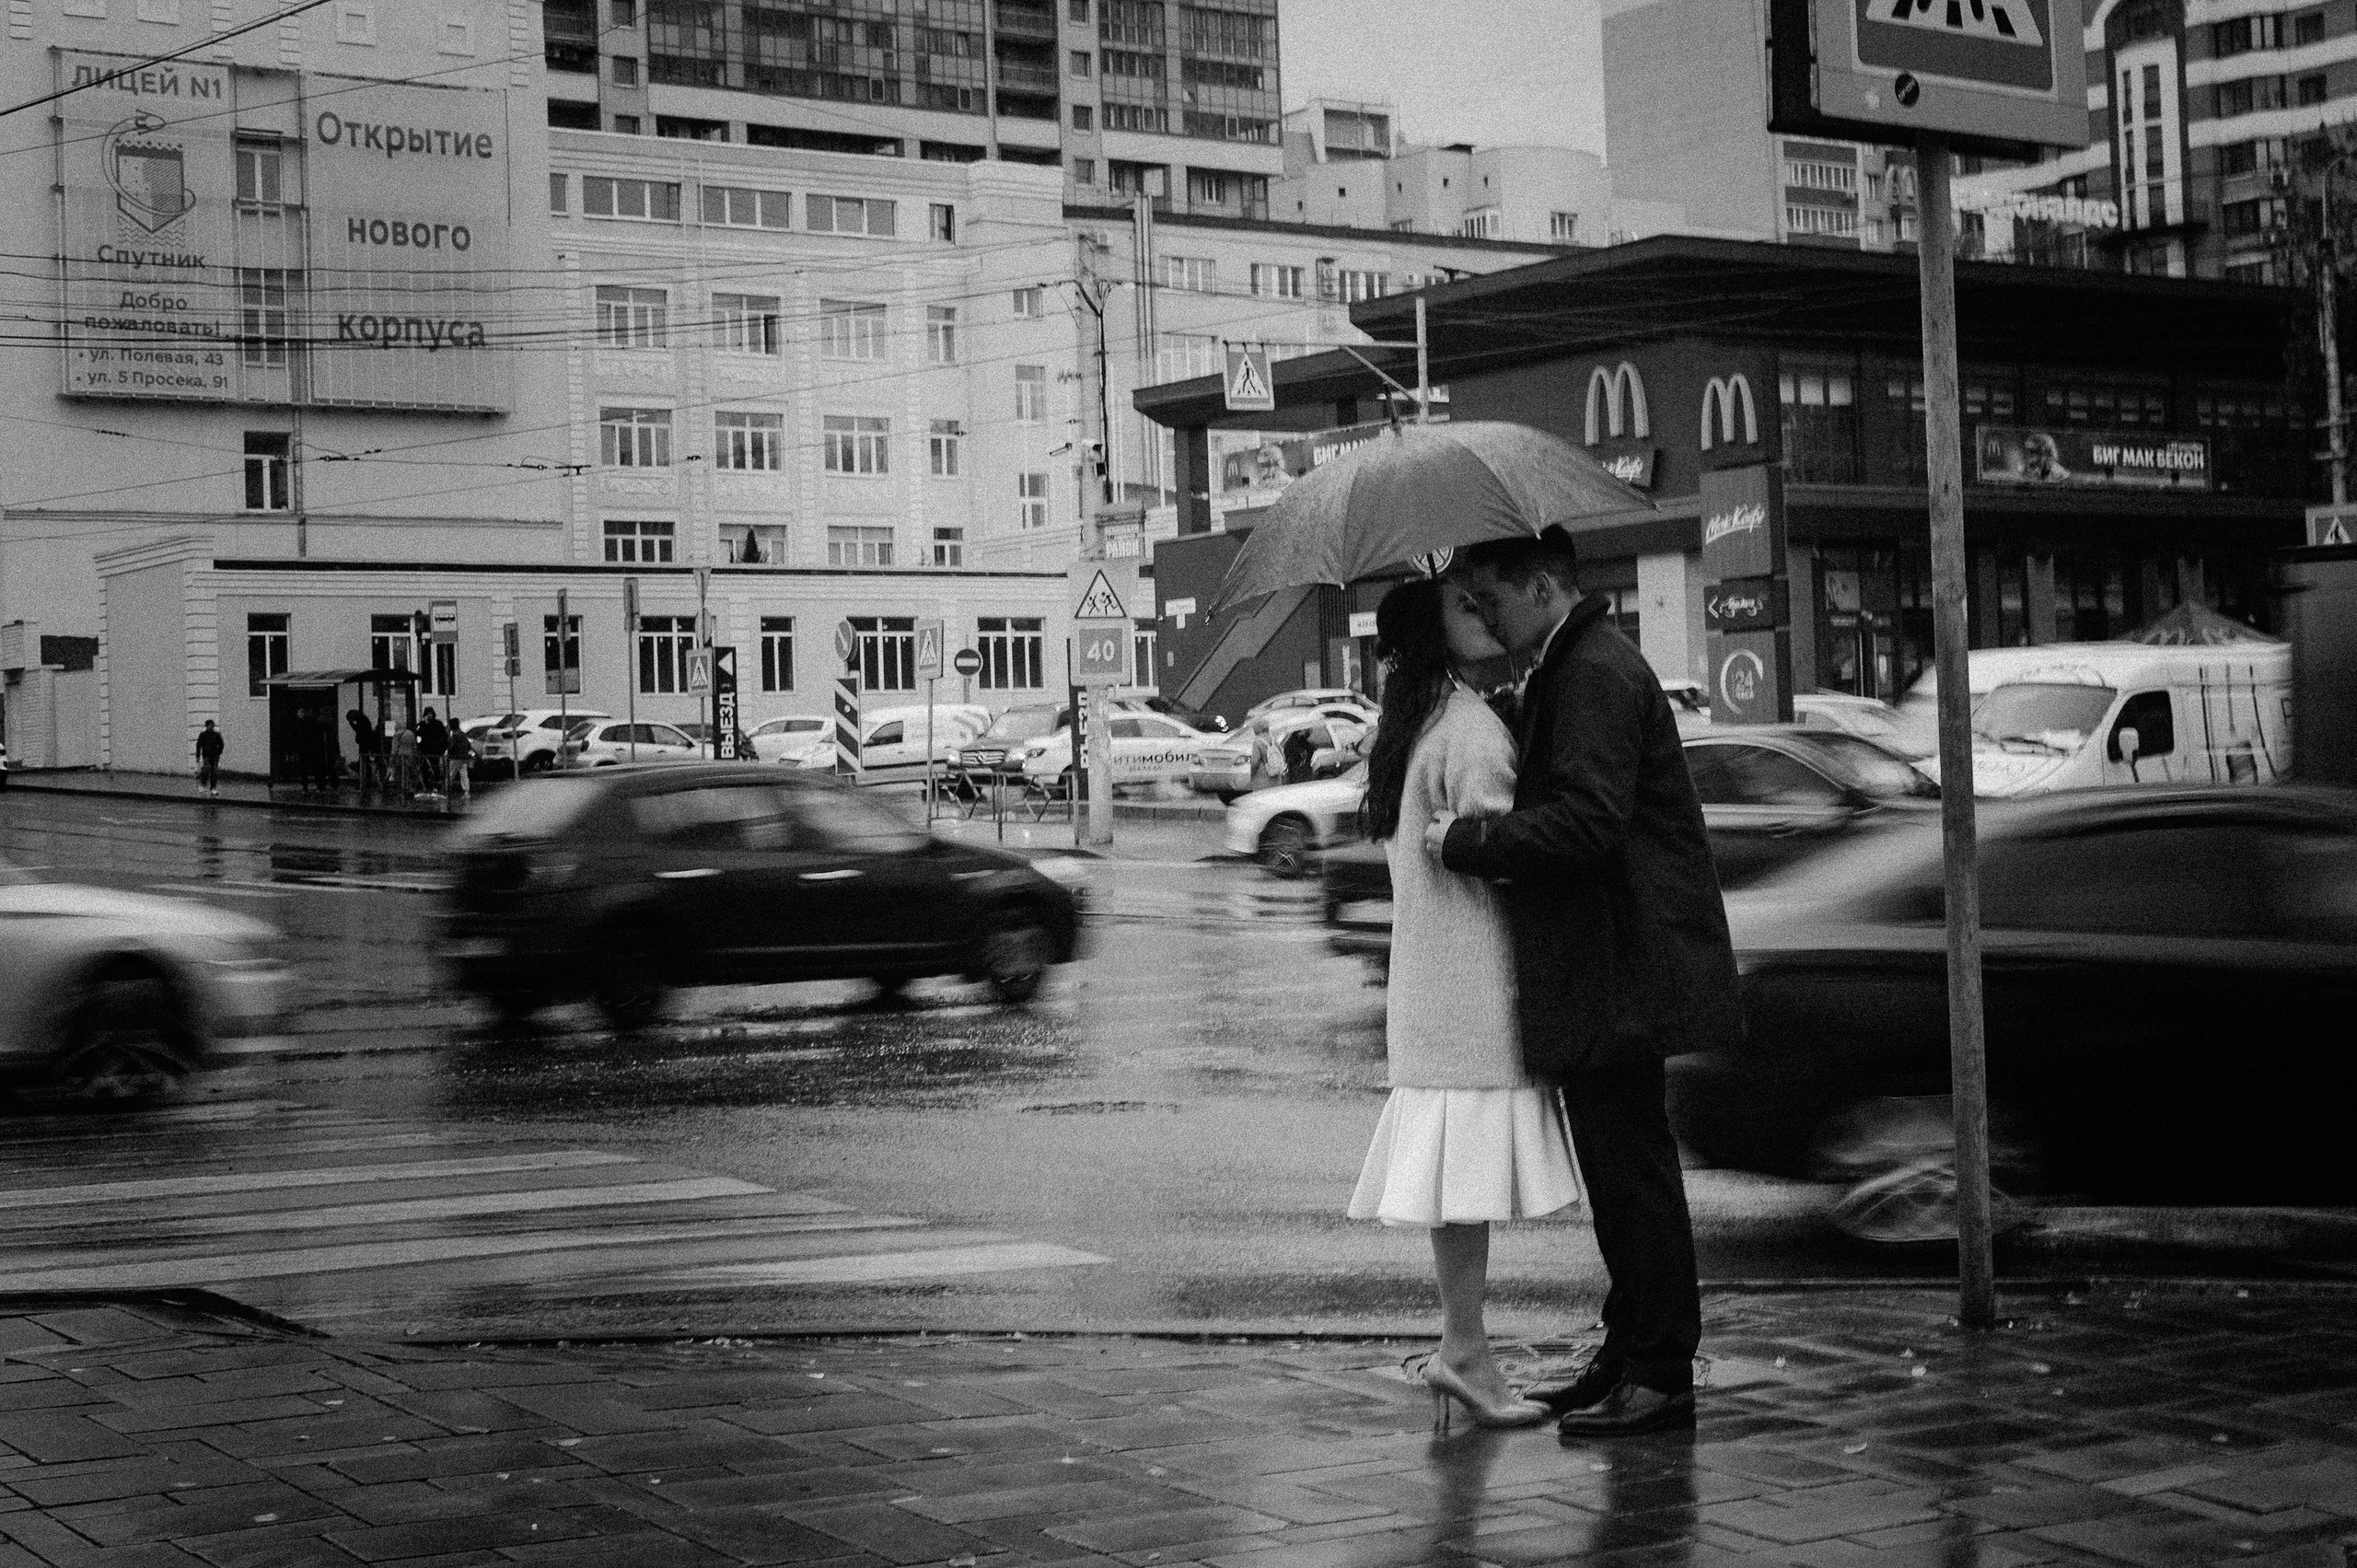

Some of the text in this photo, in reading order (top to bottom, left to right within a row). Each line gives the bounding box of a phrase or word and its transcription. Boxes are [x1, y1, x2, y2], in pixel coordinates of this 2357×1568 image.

[72, 65, 180, 96] ЛИЦЕЙ
[317, 111, 493, 159] Открытие
[347, 217, 471, 251] нового
[97, 244, 207, 270] Спутник
[119, 291, 188, 313] Добро
[85, 316, 221, 337] пожаловать!
[338, 314, 487, 353] корпуса
[89, 349, 224, 366] ул. Полевая, 43
[87, 370, 228, 389] ул. 5 Просека, 91
[2093, 444, 2205, 470] БИГ МАК БЕКОН
[1086, 640, 1115, 662] 40
[719, 692, 736, 760] ВЫЕЗД
